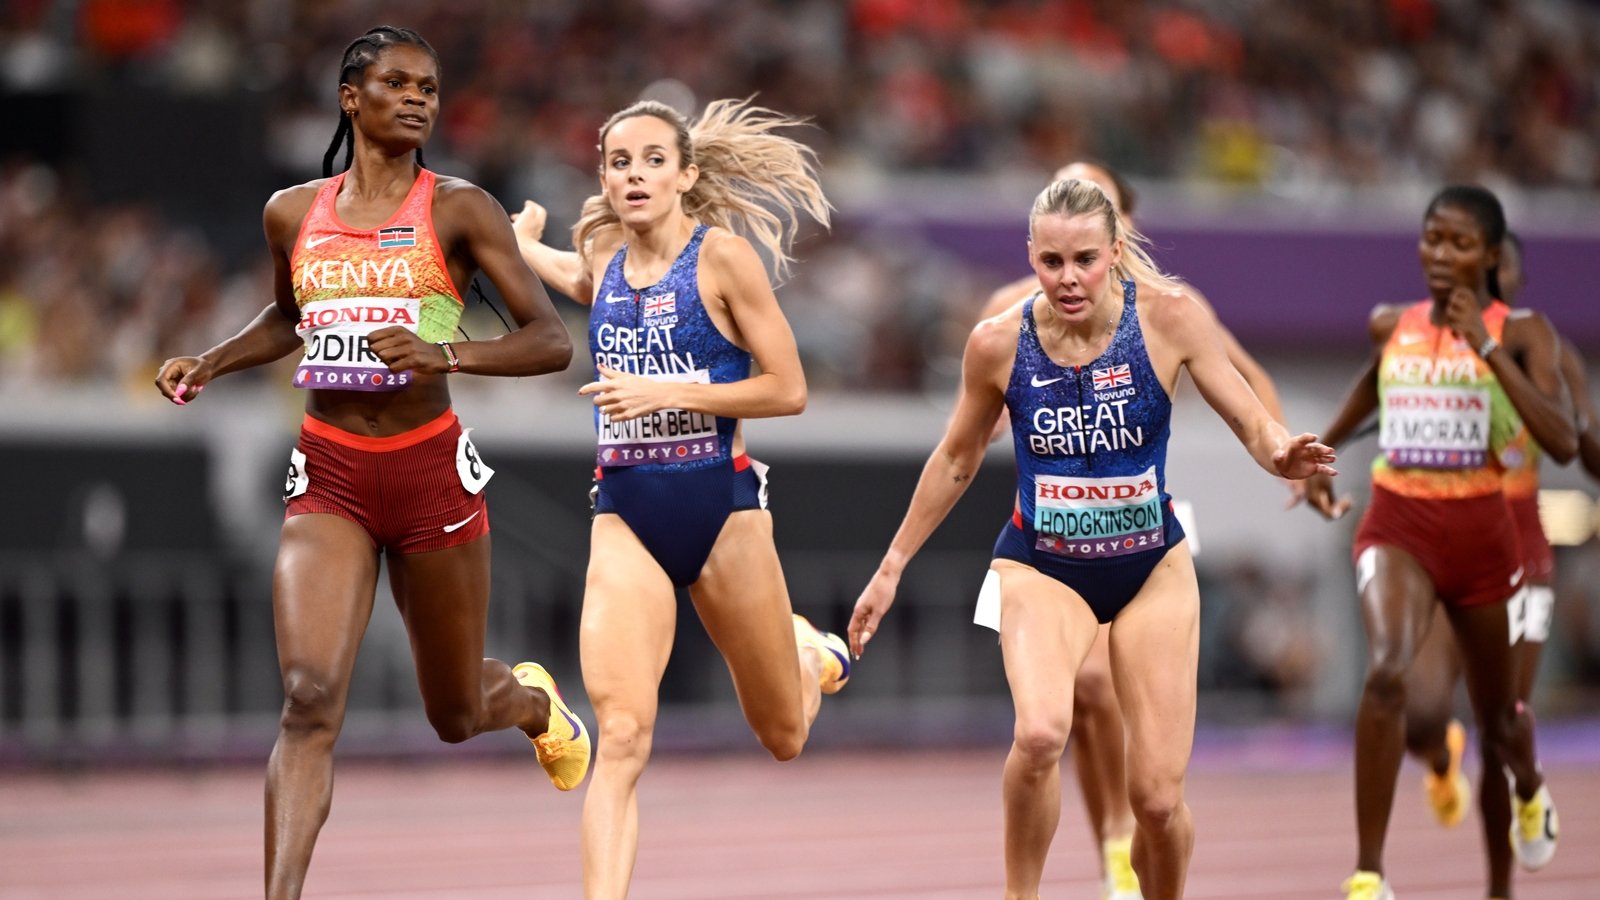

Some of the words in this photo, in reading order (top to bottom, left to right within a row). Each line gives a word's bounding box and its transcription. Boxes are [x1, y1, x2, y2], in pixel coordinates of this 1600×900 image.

[301, 258, 415, 290] KENYA
[298, 306, 416, 330] HONDA
[643, 314, 679, 327] Novuna
[307, 334, 383, 363] ODIR
[597, 323, 676, 354] GREAT
[1387, 356, 1478, 385] KENYA
[1094, 387, 1136, 402] Novuna
[1387, 394, 1485, 411] HONDA
[667, 410, 713, 437] BELL
[1033, 400, 1129, 434] GREAT
[1403, 419, 1483, 442] MORAA
[1029, 426, 1143, 455] BRITAIN
[465, 441, 481, 481] 8
[1039, 479, 1154, 500] HONDA
[1041, 501, 1158, 537] HODGKINSON
